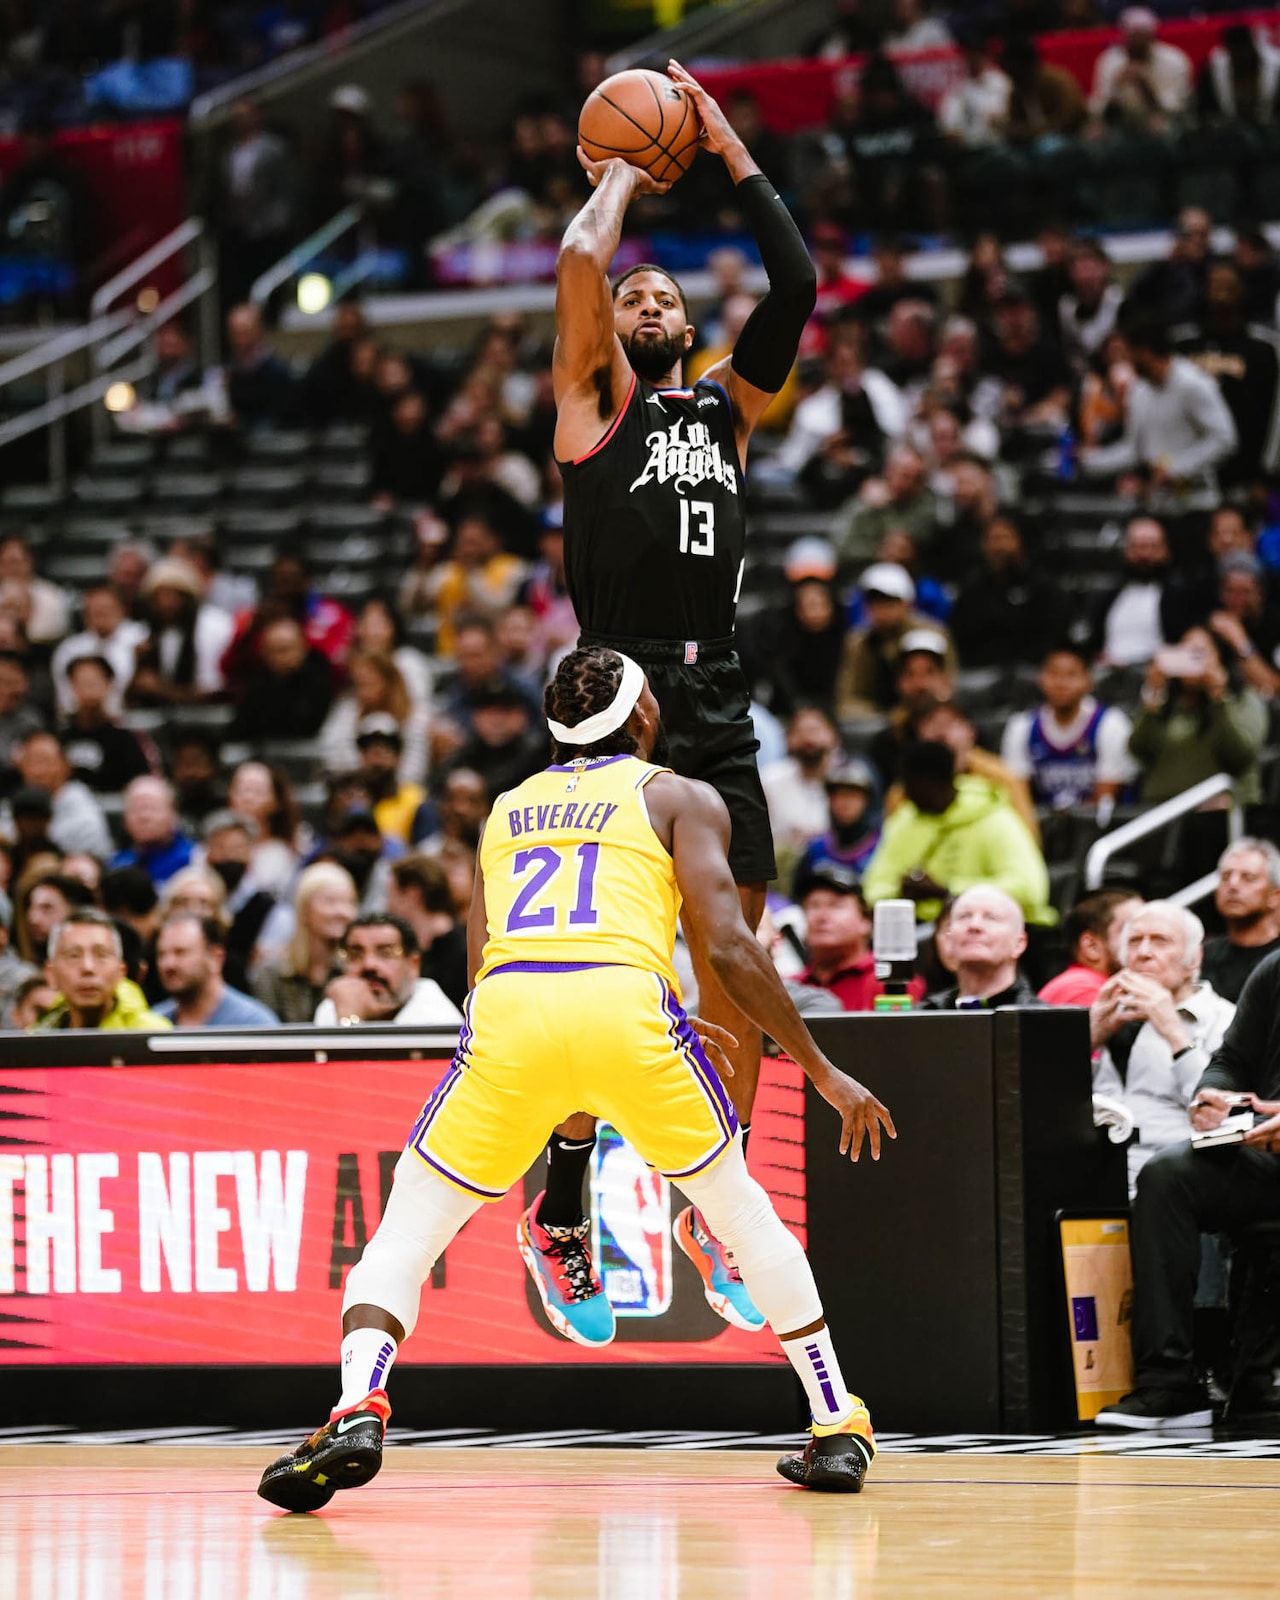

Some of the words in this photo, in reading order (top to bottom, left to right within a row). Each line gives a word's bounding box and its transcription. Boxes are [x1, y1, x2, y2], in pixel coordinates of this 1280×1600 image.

[666, 416, 711, 453] Los
[679, 499, 715, 557] 13
[508, 802, 619, 838] BEVERLEY
[504, 842, 601, 934] 21
[0, 1152, 121, 1293] THE
[138, 1150, 308, 1292] NEW
